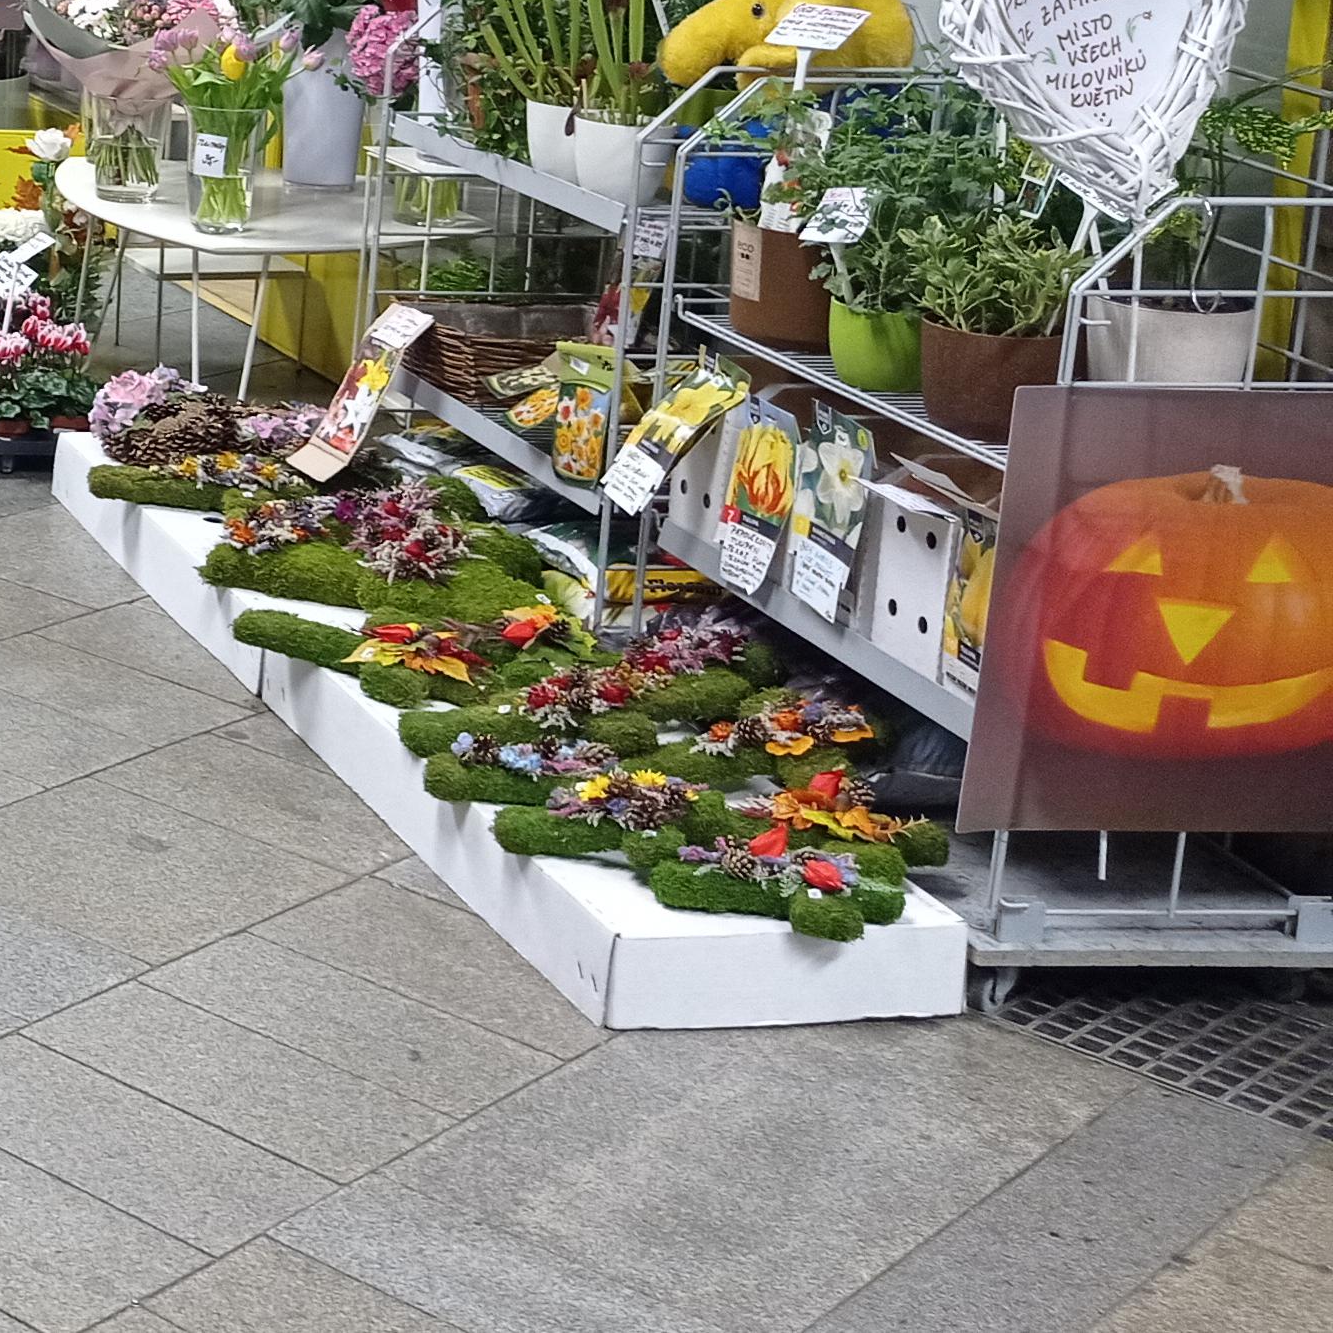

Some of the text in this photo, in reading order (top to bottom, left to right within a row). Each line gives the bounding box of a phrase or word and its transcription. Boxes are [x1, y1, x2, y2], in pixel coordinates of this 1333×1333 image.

[1018, 21, 1034, 46] JE
[1068, 36, 1122, 66] VŠECH
[1071, 79, 1134, 108] KVĚTIN
